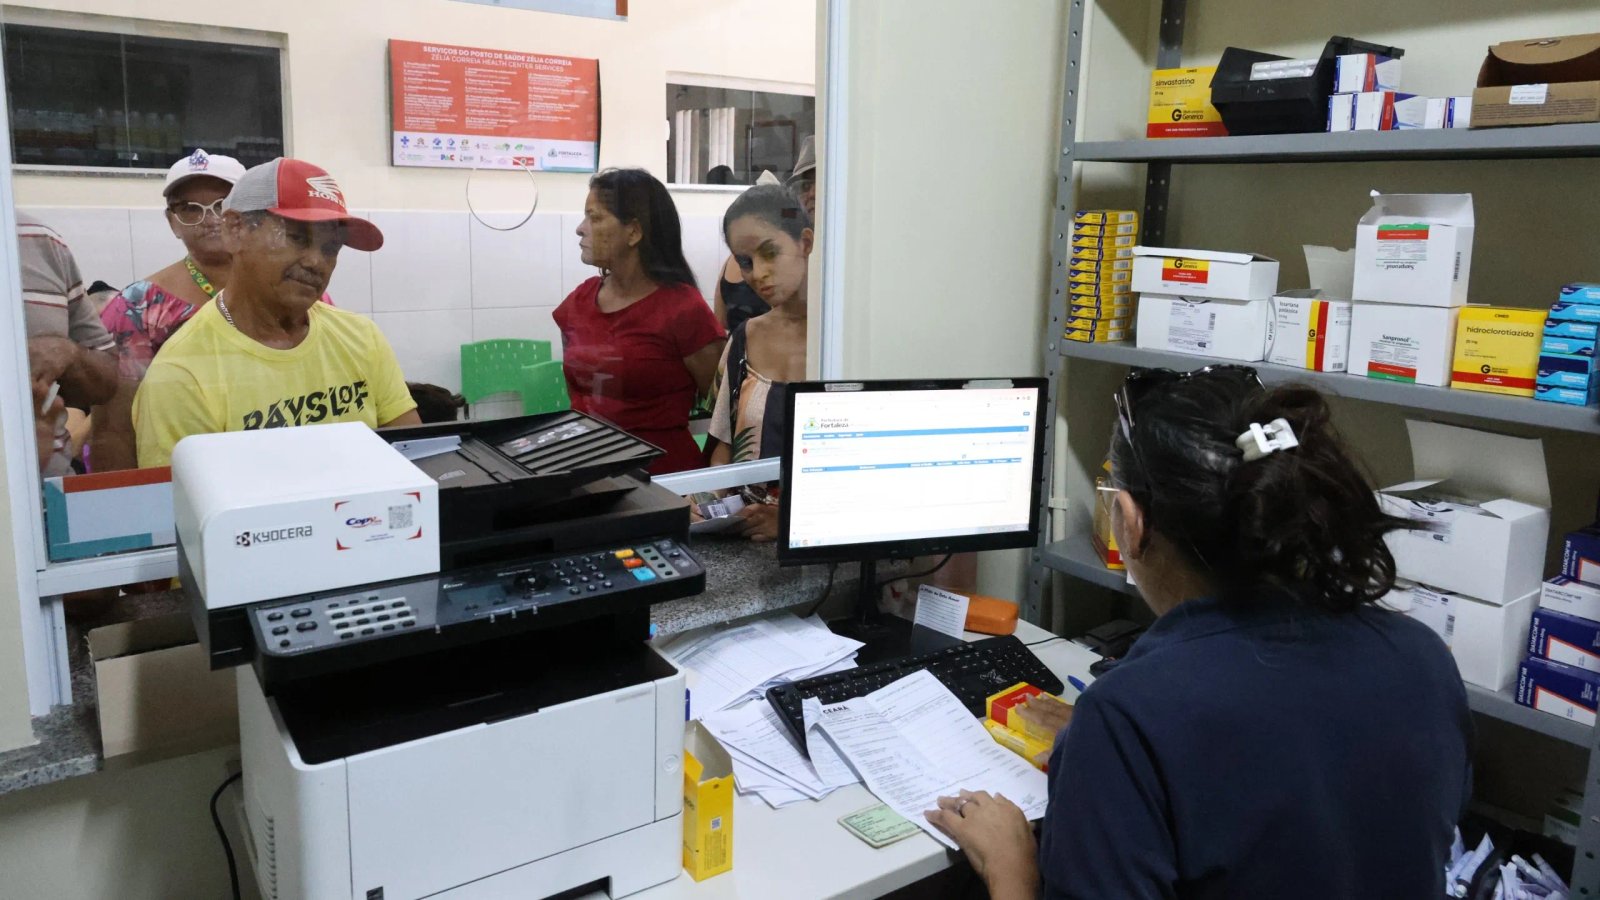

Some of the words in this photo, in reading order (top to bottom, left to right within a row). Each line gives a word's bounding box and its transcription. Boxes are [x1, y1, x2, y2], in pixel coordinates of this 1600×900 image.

[423, 46, 457, 55] SERVIÇOS
[470, 50, 493, 58] POSTO
[504, 53, 525, 61] SAÚDE
[545, 58, 572, 66] CORREIA
[452, 56, 481, 65] CORREIA
[482, 59, 507, 67] HEALTH
[508, 61, 534, 69] CENTER
[1155, 78, 1195, 86] sinvastatina
[1171, 108, 1183, 121] G
[1308, 329, 1316, 338] G
[1466, 326, 1534, 338] hidroclorotiazida
[1480, 364, 1491, 374] G
[252, 525, 313, 544] KYOCERA
